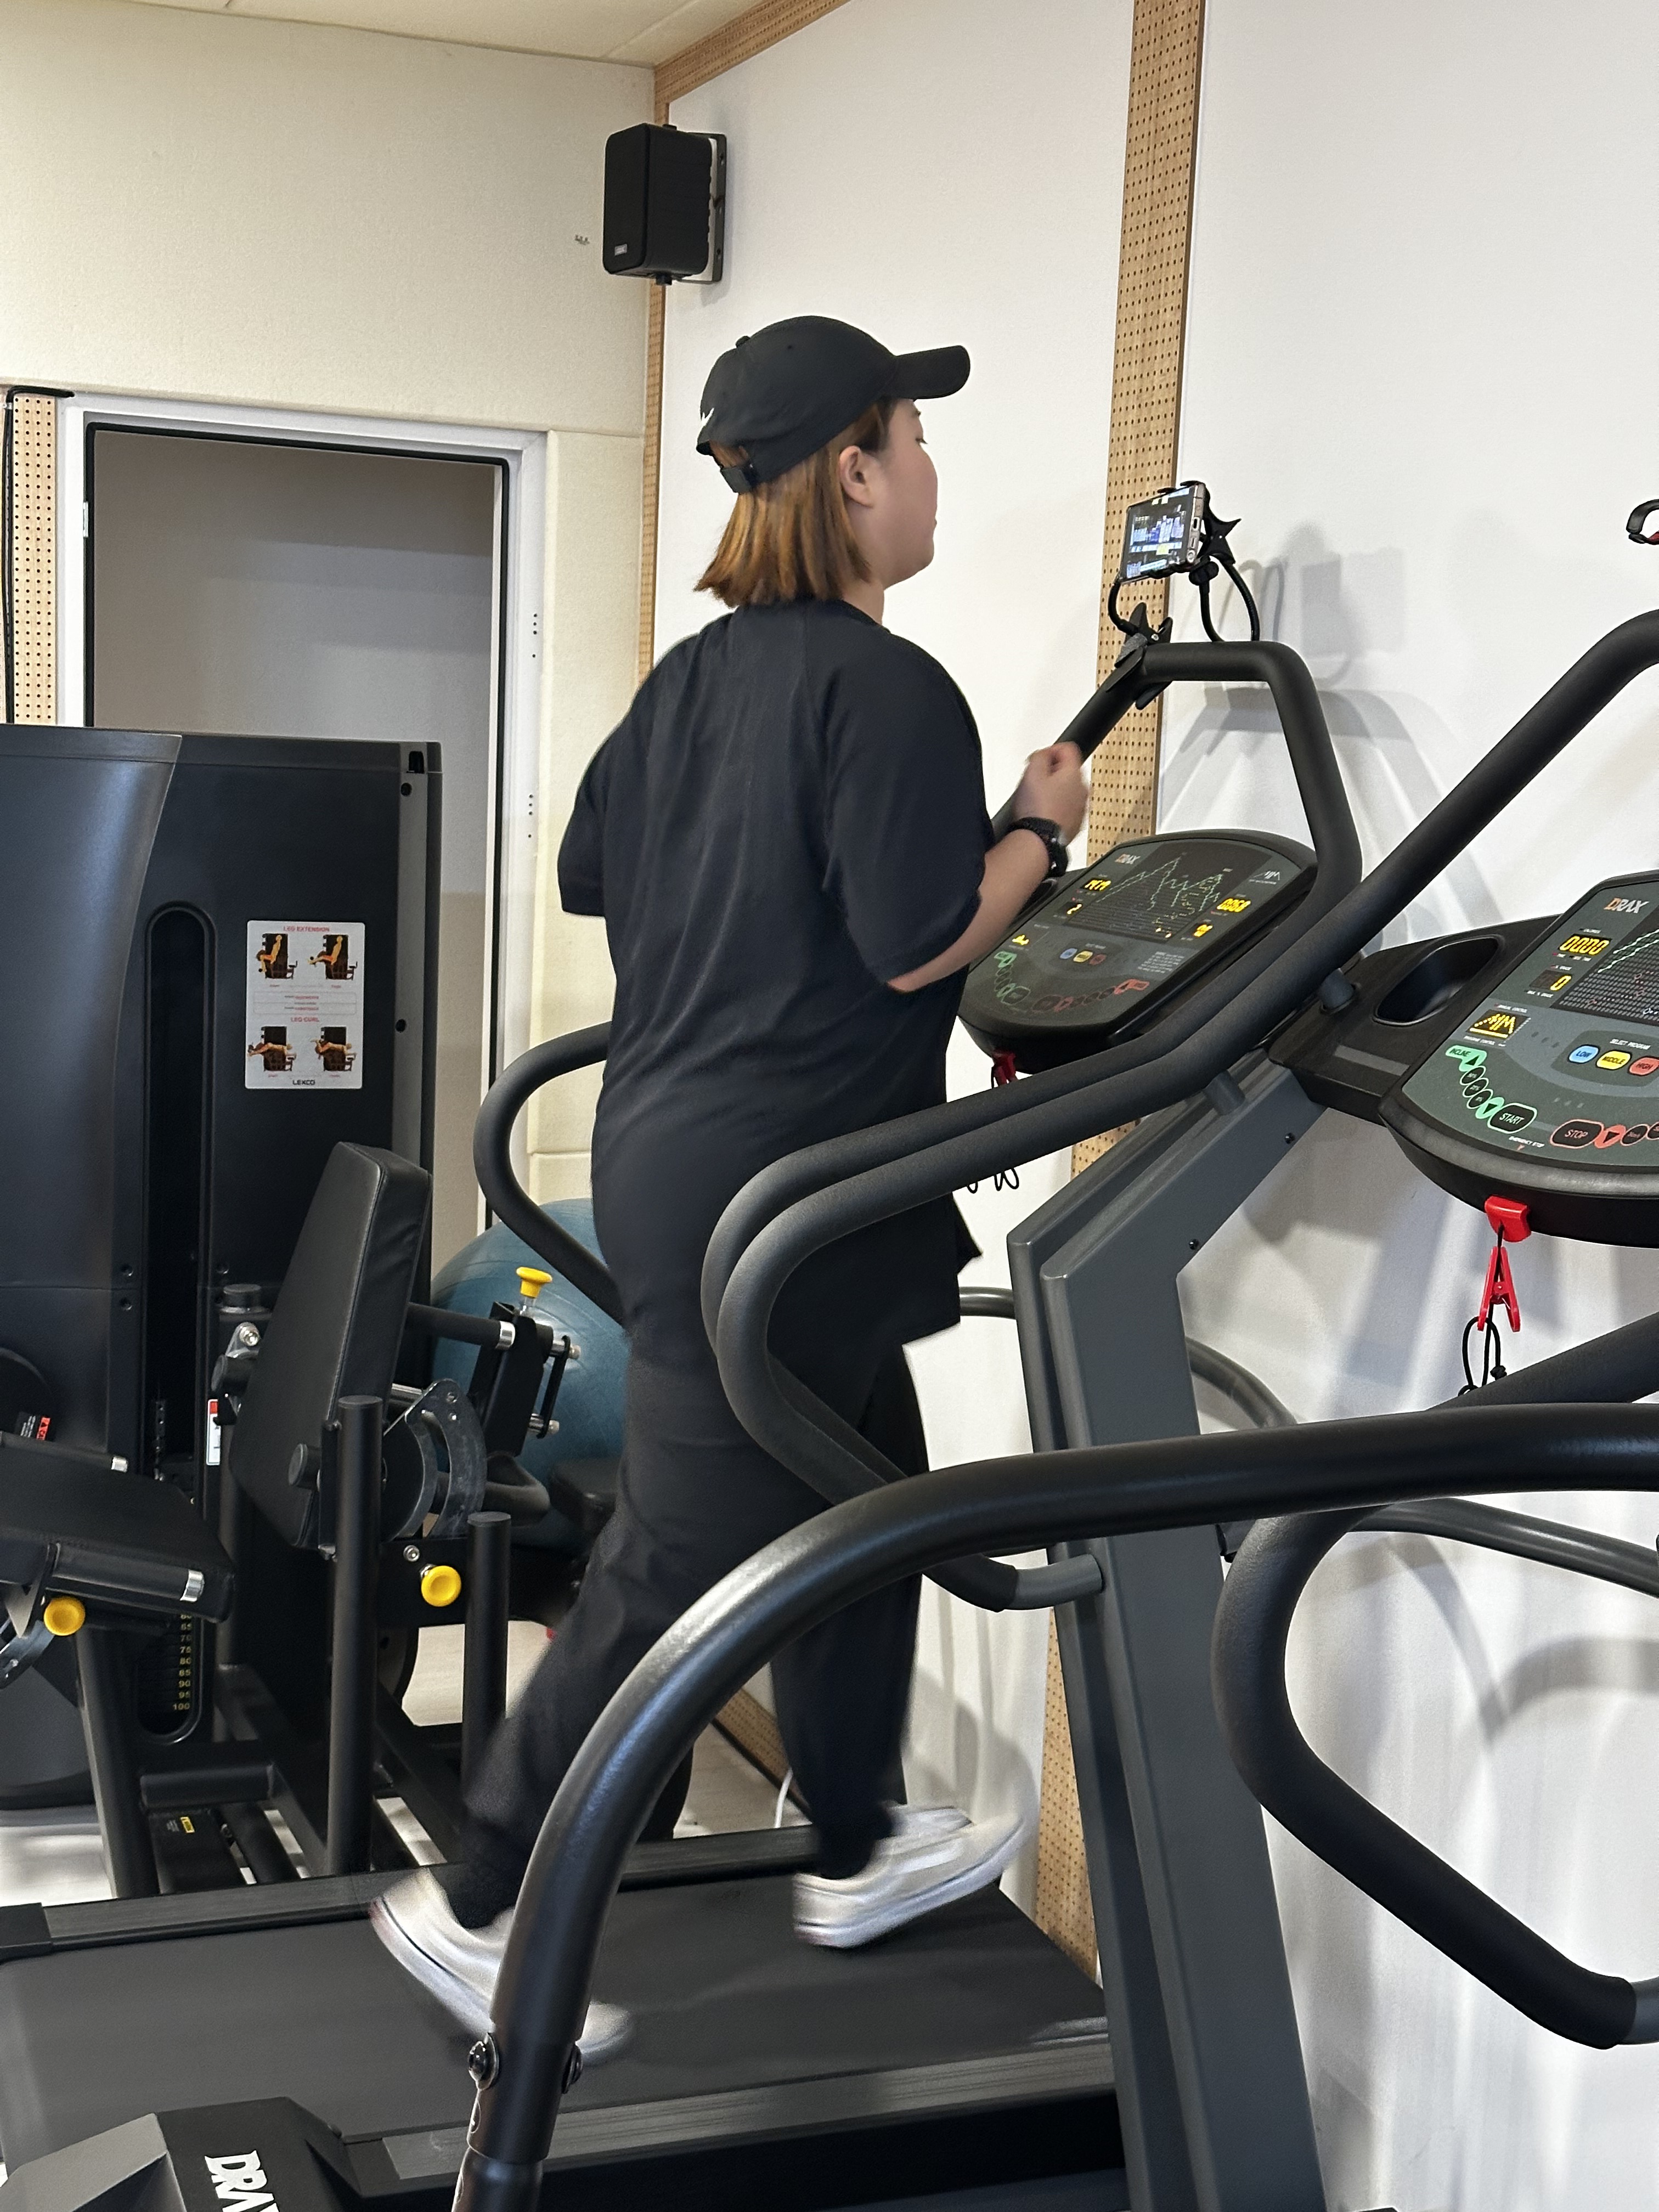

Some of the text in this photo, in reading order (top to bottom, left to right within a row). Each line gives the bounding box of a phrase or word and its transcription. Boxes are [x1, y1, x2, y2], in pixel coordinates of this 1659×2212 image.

[1604, 898, 1650, 913] DRAX
[1627, 1042, 1651, 1050] PROGRAM
[1449, 1048, 1471, 1057] INCLINE
[1601, 1056, 1626, 1065] MIDDLE
[1499, 1113, 1525, 1125] START
[1565, 1129, 1588, 1138] STOP
[204, 2150, 280, 2212] DRA
